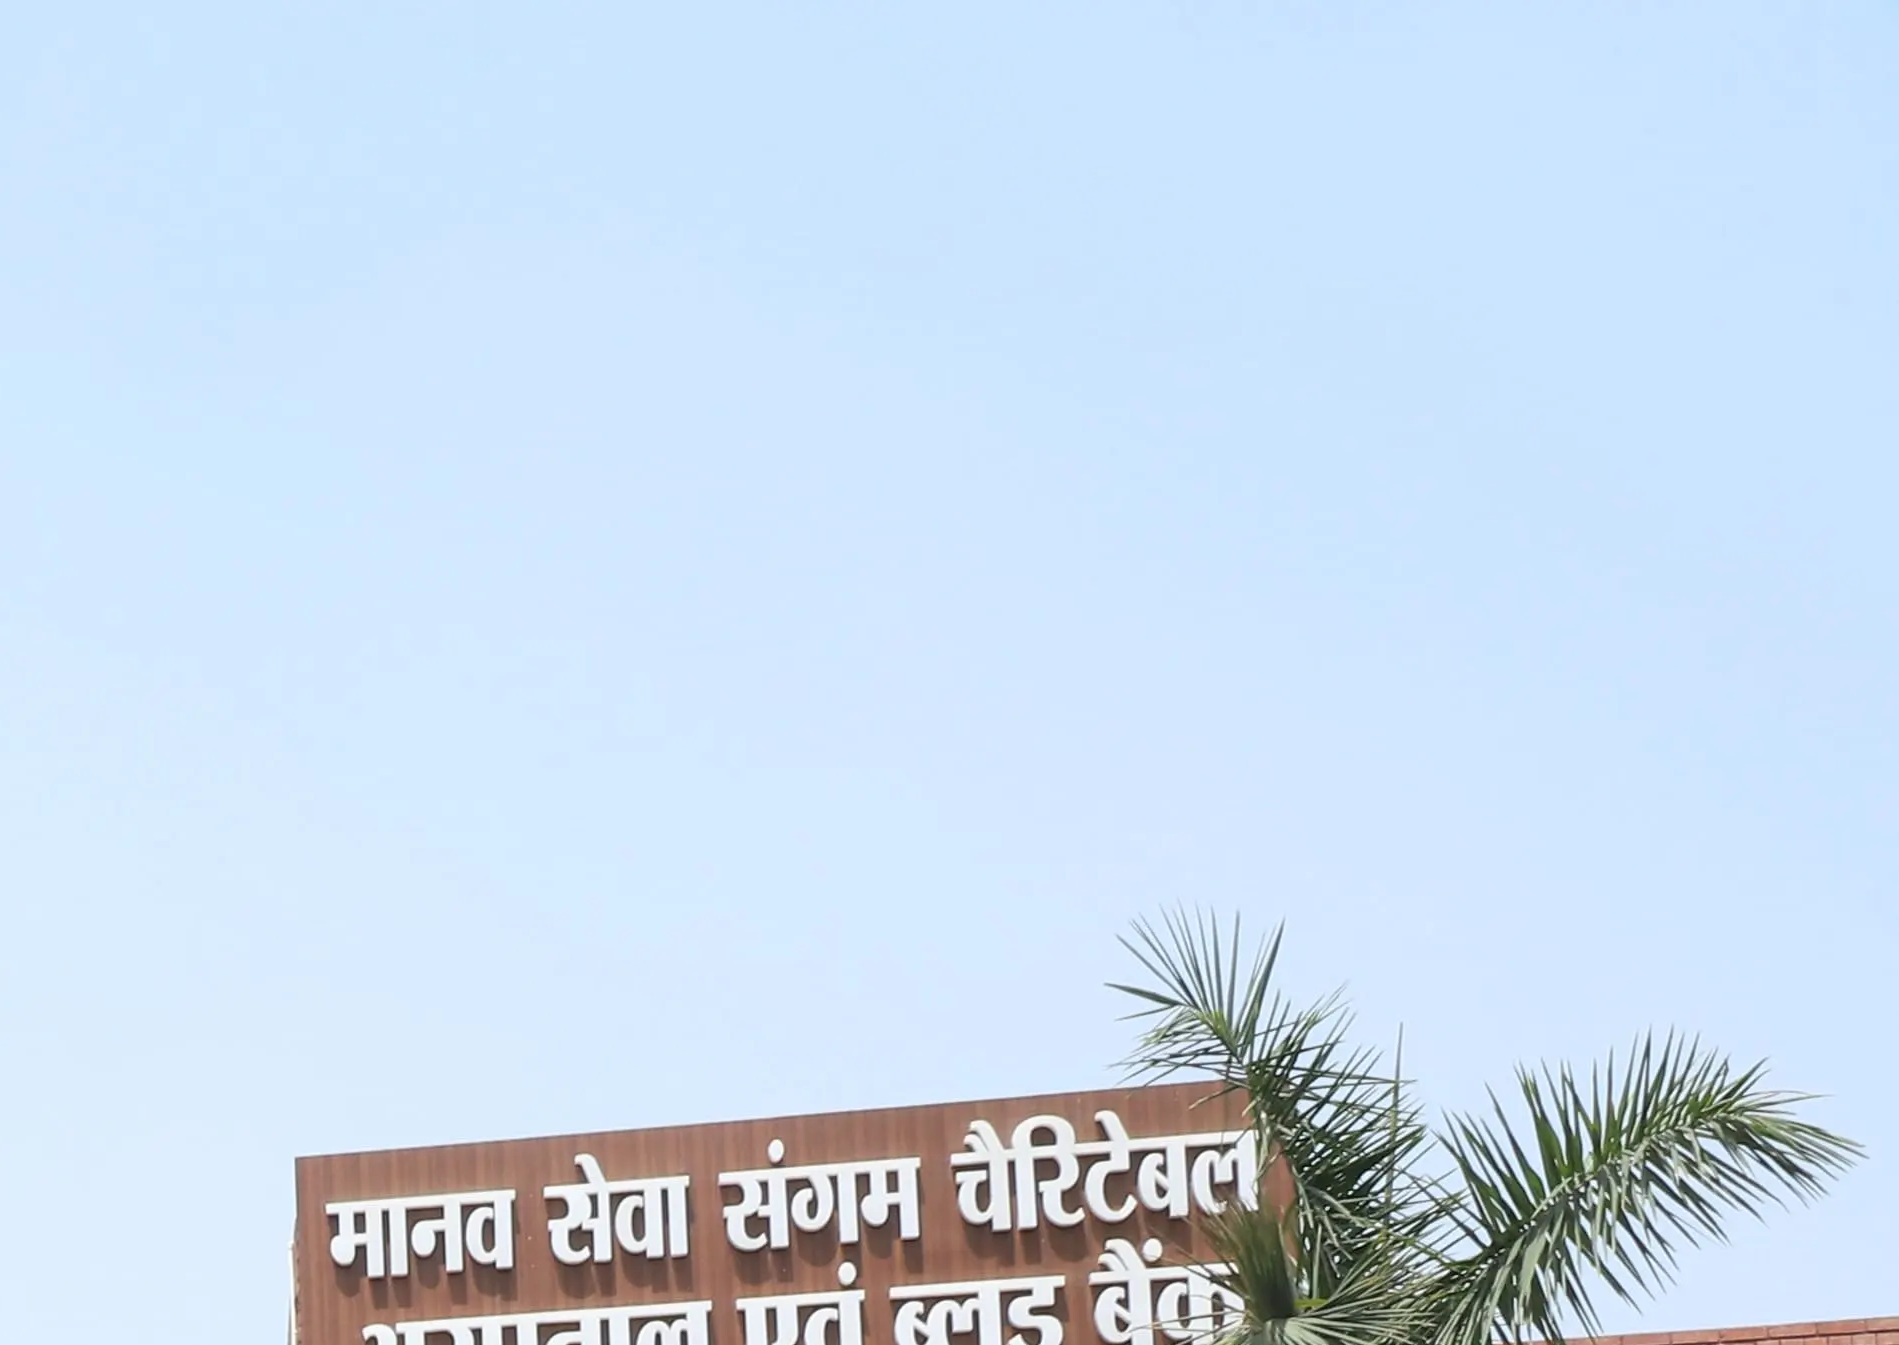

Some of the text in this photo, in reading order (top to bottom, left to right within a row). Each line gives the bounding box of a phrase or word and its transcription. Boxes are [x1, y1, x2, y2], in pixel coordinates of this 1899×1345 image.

[327, 1110, 1259, 1279] मानव सेवा संगम चैरिटेबल
